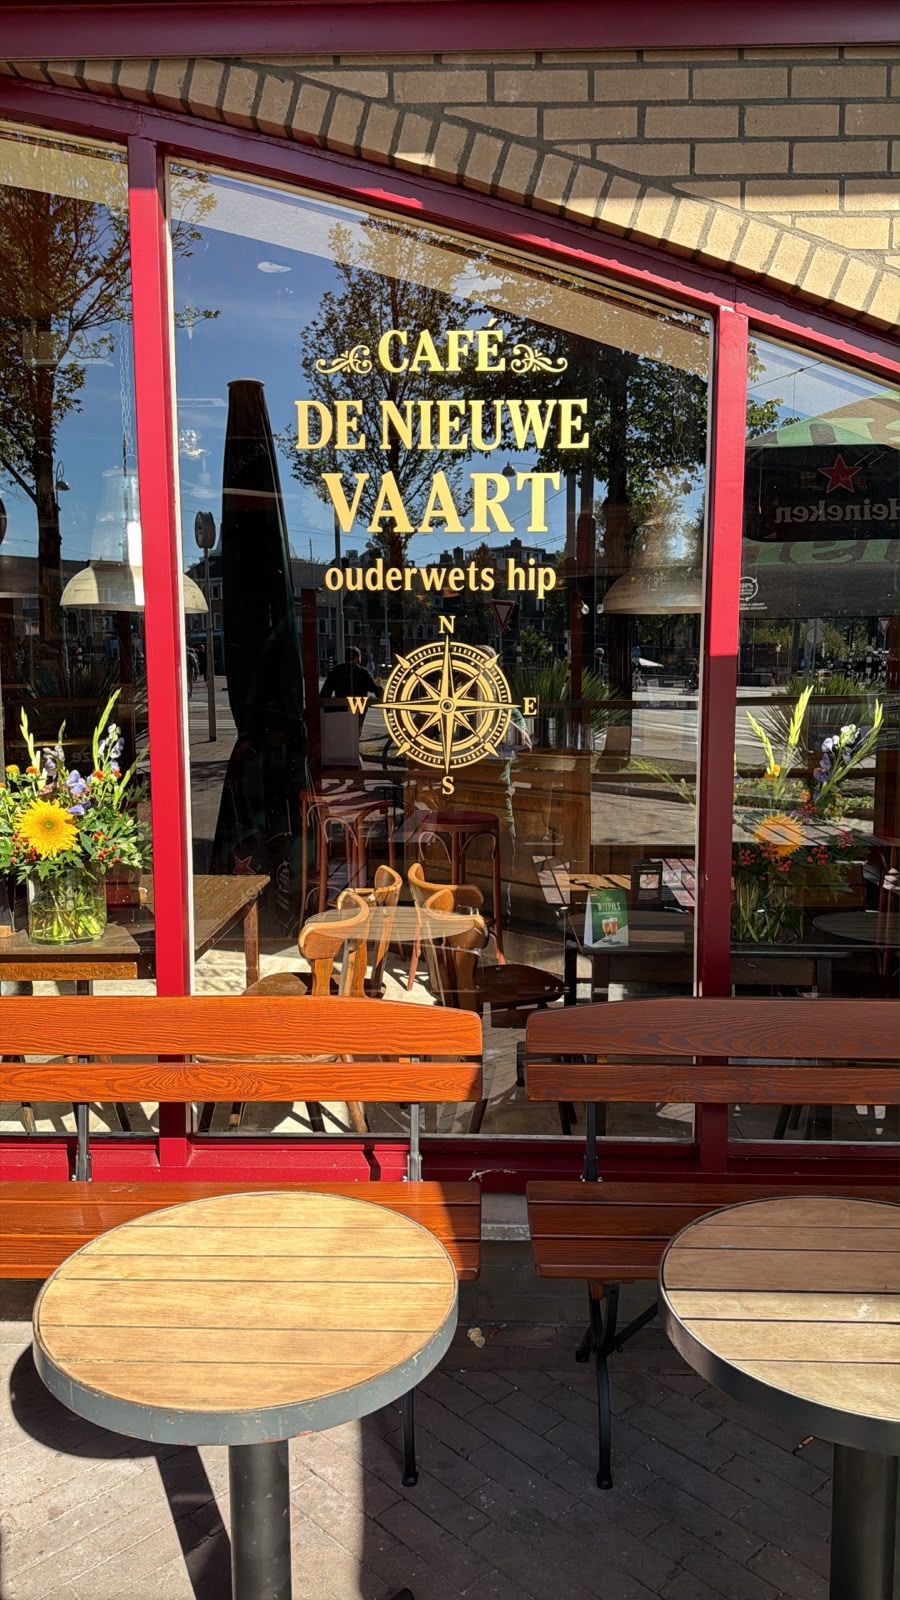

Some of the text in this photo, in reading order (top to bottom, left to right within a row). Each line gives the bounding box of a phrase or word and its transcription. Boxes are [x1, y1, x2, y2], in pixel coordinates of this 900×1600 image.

[378, 318, 506, 373] CAFÉ
[294, 398, 590, 451] DE NIEUWE
[321, 470, 560, 533] VAART
[325, 558, 557, 600] ouderwets hip
[438, 615, 456, 634] N
[347, 696, 369, 715] W
[522, 697, 537, 716] E
[442, 776, 455, 795] S
